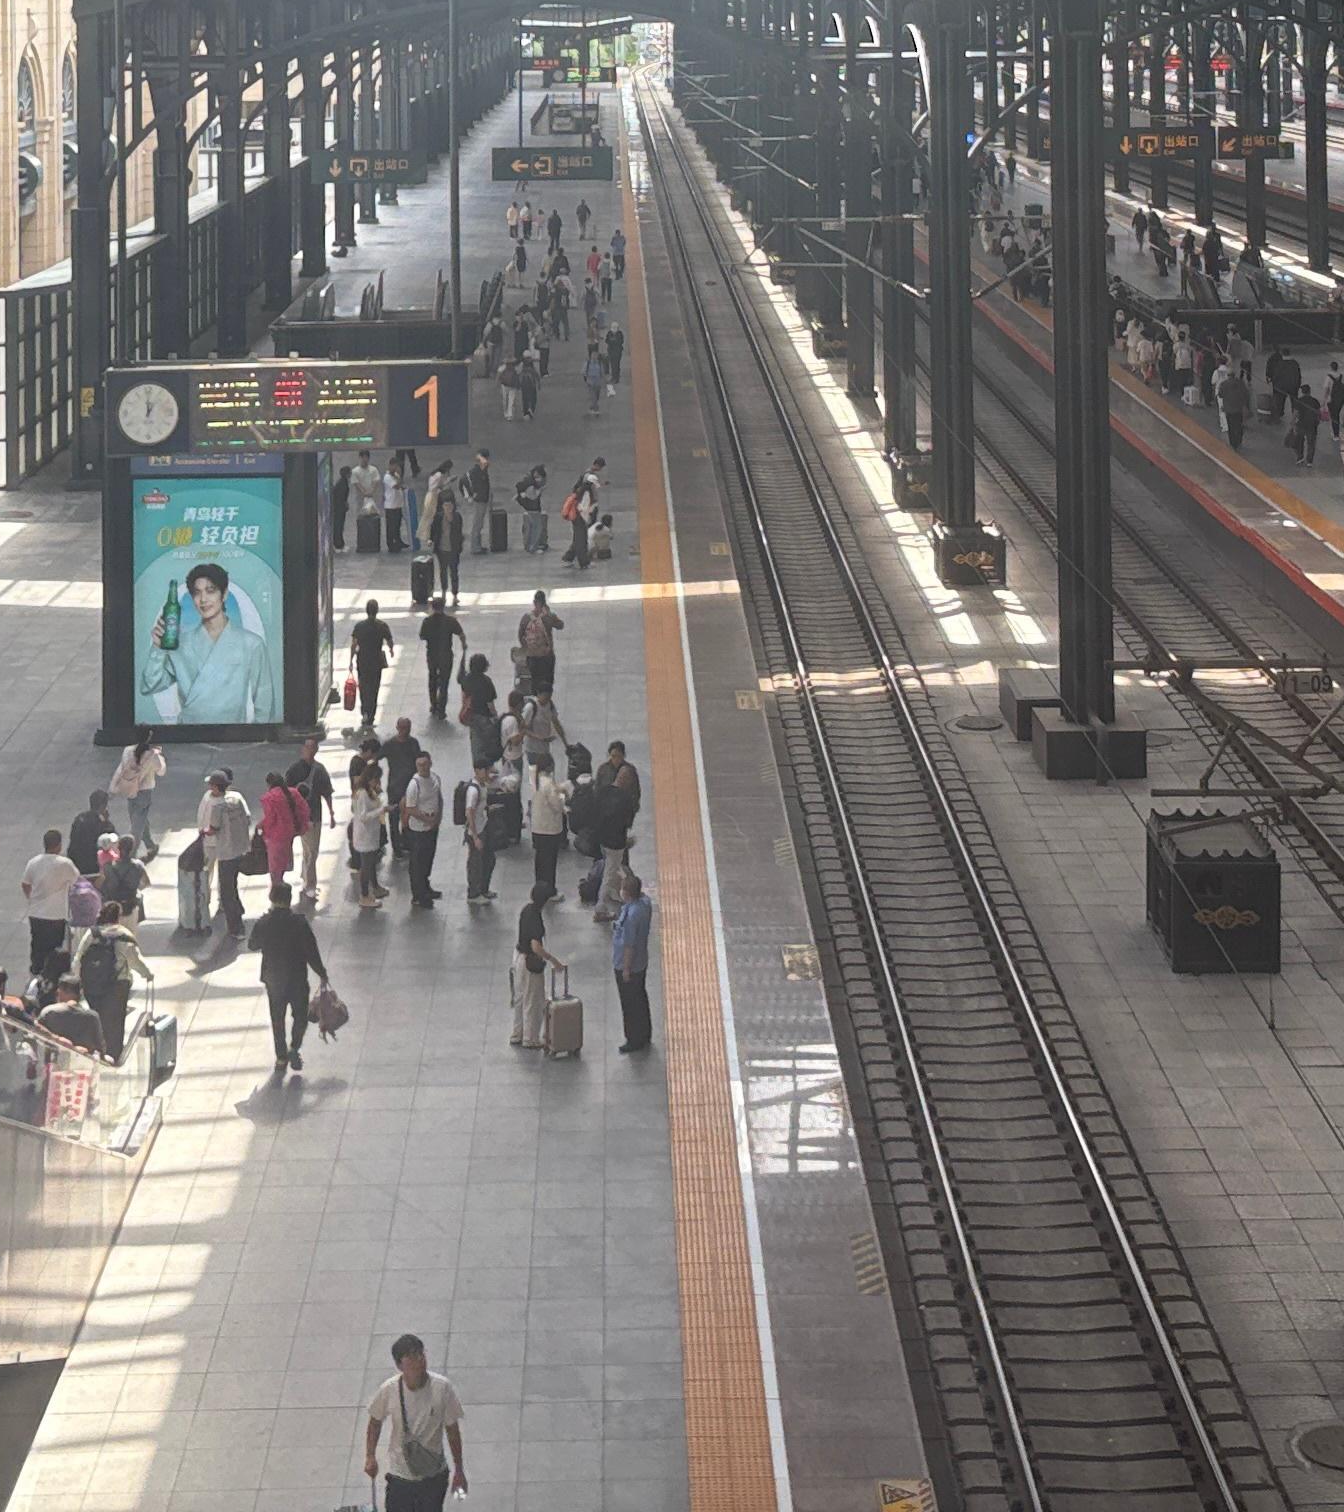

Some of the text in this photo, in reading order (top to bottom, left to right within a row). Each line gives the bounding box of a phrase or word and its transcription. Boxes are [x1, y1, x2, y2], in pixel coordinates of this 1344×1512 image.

[1164, 135, 1199, 147] 出站口
[1242, 135, 1277, 148] 出站口
[374, 158, 409, 171] 出站口
[557, 155, 593, 169] 出站口
[414, 375, 439, 438] 1
[199, 525, 261, 545] 轻负担
[1279, 674, 1333, 693] Y1-09
